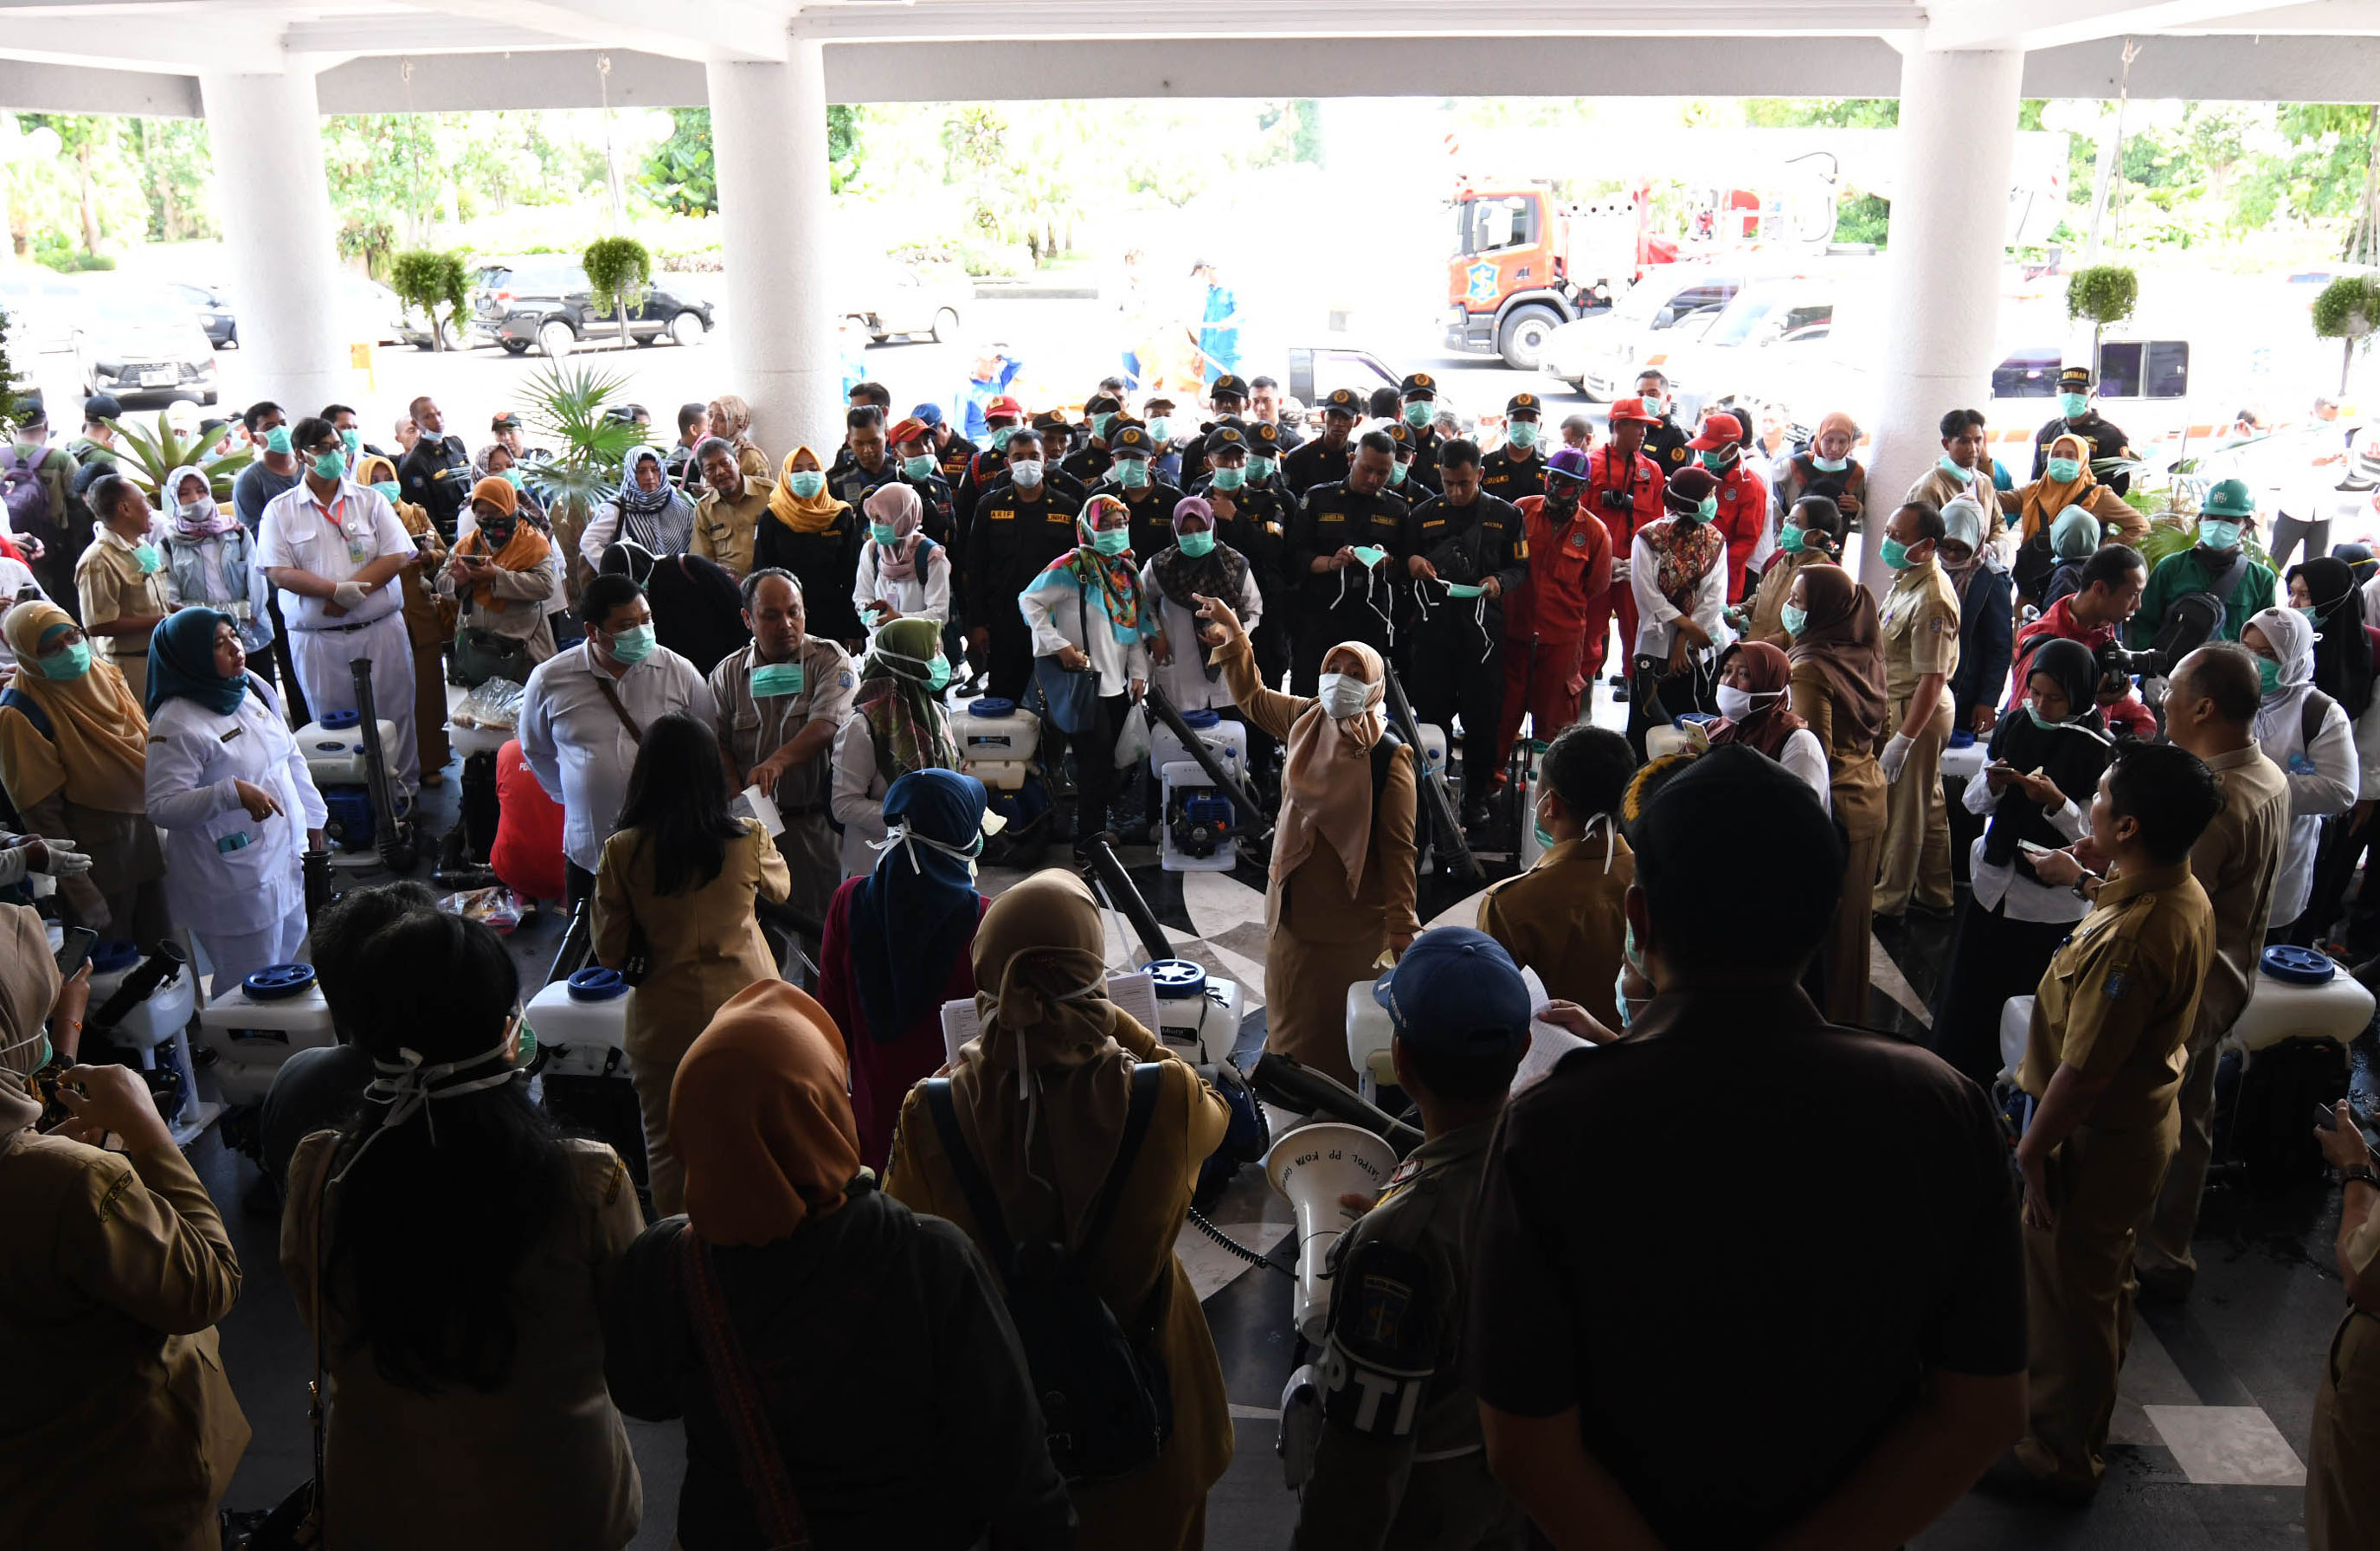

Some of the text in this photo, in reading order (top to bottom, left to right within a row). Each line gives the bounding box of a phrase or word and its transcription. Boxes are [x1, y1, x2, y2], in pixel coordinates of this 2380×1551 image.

[1295, 1150, 1319, 1167] KOTA
[1328, 1149, 1341, 1160] PP
[1352, 1154, 1380, 1181] SATPOL
